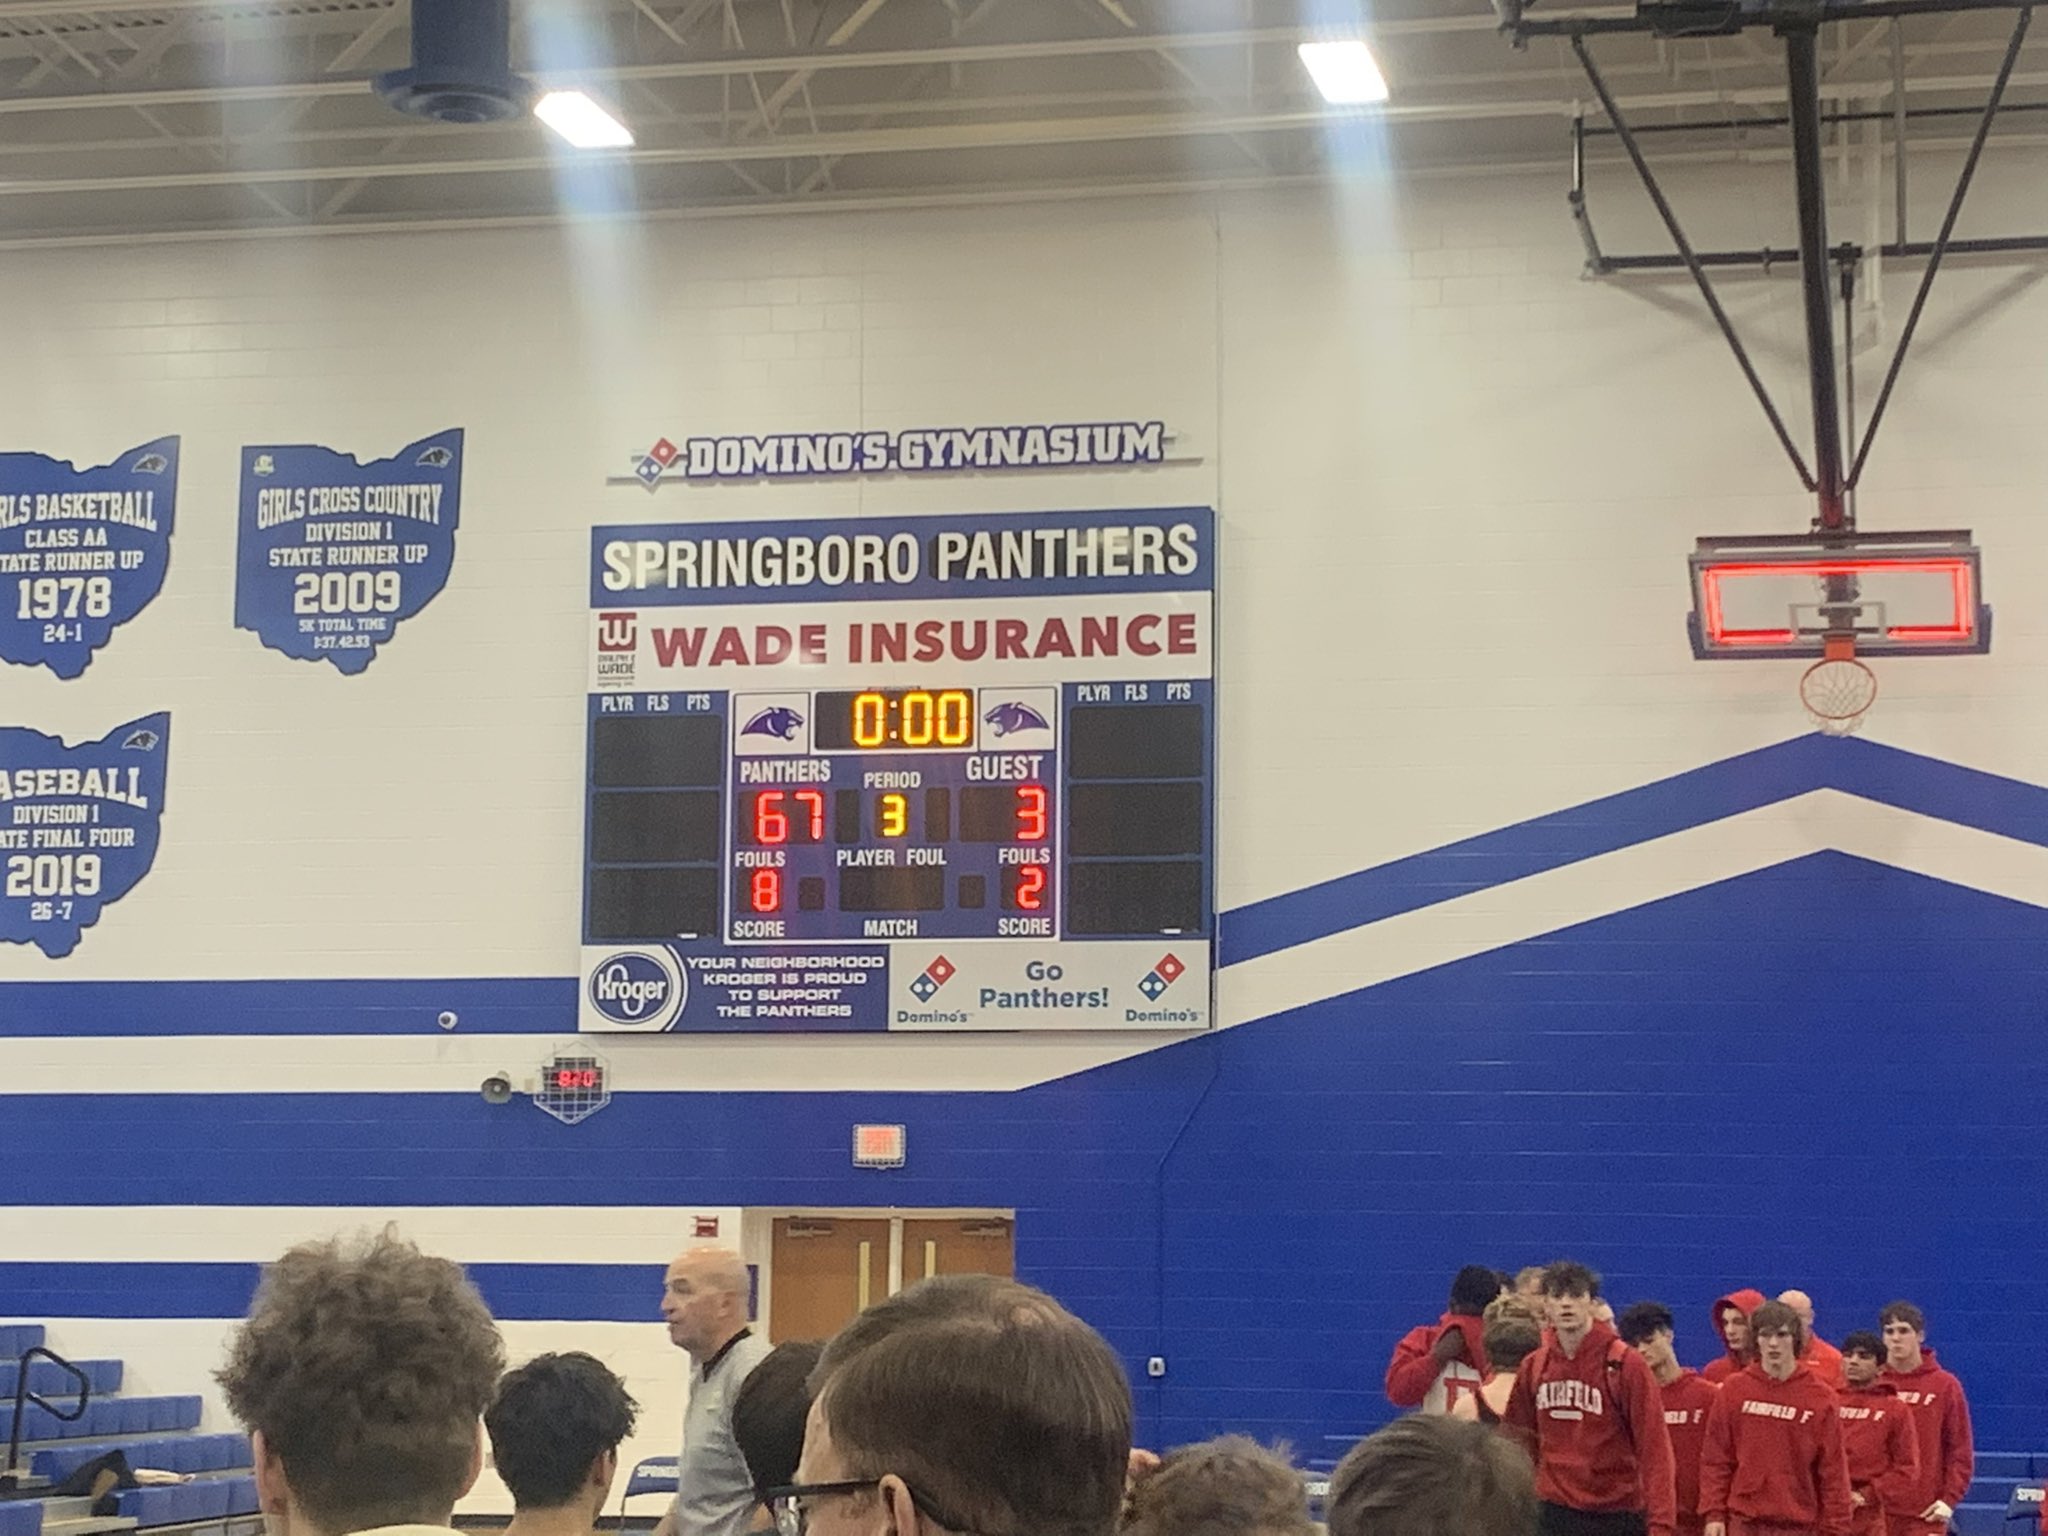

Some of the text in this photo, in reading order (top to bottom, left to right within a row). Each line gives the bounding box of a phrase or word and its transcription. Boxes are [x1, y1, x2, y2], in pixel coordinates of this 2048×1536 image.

[686, 422, 1165, 477] DOMINO'S GYMNASIUM
[0, 491, 157, 532] RLS BASKETBALL
[257, 484, 443, 530] GIRLS CROSS COUNTRY
[25, 528, 108, 548] CLASS AA
[306, 522, 393, 543] DIVISION 1
[0, 551, 144, 573] TATE RUNNER UP
[269, 546, 428, 567] STATE RUNNER UP
[602, 523, 1199, 592] SPRINGBORO PANTHERS
[17, 577, 112, 619] 1978
[294, 571, 401, 614] 2009
[44, 623, 82, 643] 24-1
[318, 618, 354, 632] TOTAL
[357, 617, 386, 631] TIME
[651, 614, 1197, 667] WADE INSURANCE
[1077, 681, 1192, 702] PLYR FLS PTS
[602, 694, 711, 712] PLYR FLS PTS
[854, 692, 968, 746] 0:00
[740, 760, 831, 783] PANTHERS
[966, 755, 1044, 781] GUEST
[0, 768, 147, 809] ASEBALL
[864, 771, 921, 789] PERIOD
[13, 805, 99, 824] DIVISION 1
[756, 790, 824, 844] 67
[882, 793, 907, 837] 3
[1016, 785, 1047, 841] 3
[33, 829, 84, 848] FINAL
[89, 828, 134, 847] FOUR
[735, 850, 786, 868] FOULS
[836, 848, 947, 866] PLAYER FOUL
[998, 847, 1050, 865] FOULS
[6, 854, 101, 897] 2019
[752, 868, 779, 912] 8
[1016, 866, 1045, 910] 2
[733, 920, 785, 938] SCORE
[864, 919, 918, 937] MATCH
[998, 918, 1050, 936] SCORE
[687, 956, 885, 970] YOUR NEIGHBORHOOD
[1026, 961, 1063, 981] Go
[598, 963, 666, 1016] Kroger
[704, 972, 867, 986] KROGER IS PROUD
[728, 988, 841, 1002] TO SUPPORT
[979, 987, 1109, 1008] Panthers!
[717, 1004, 852, 1018] THE PANTHERS
[897, 1009, 968, 1024] Domino's
[1125, 1007, 1199, 1022] Domino's
